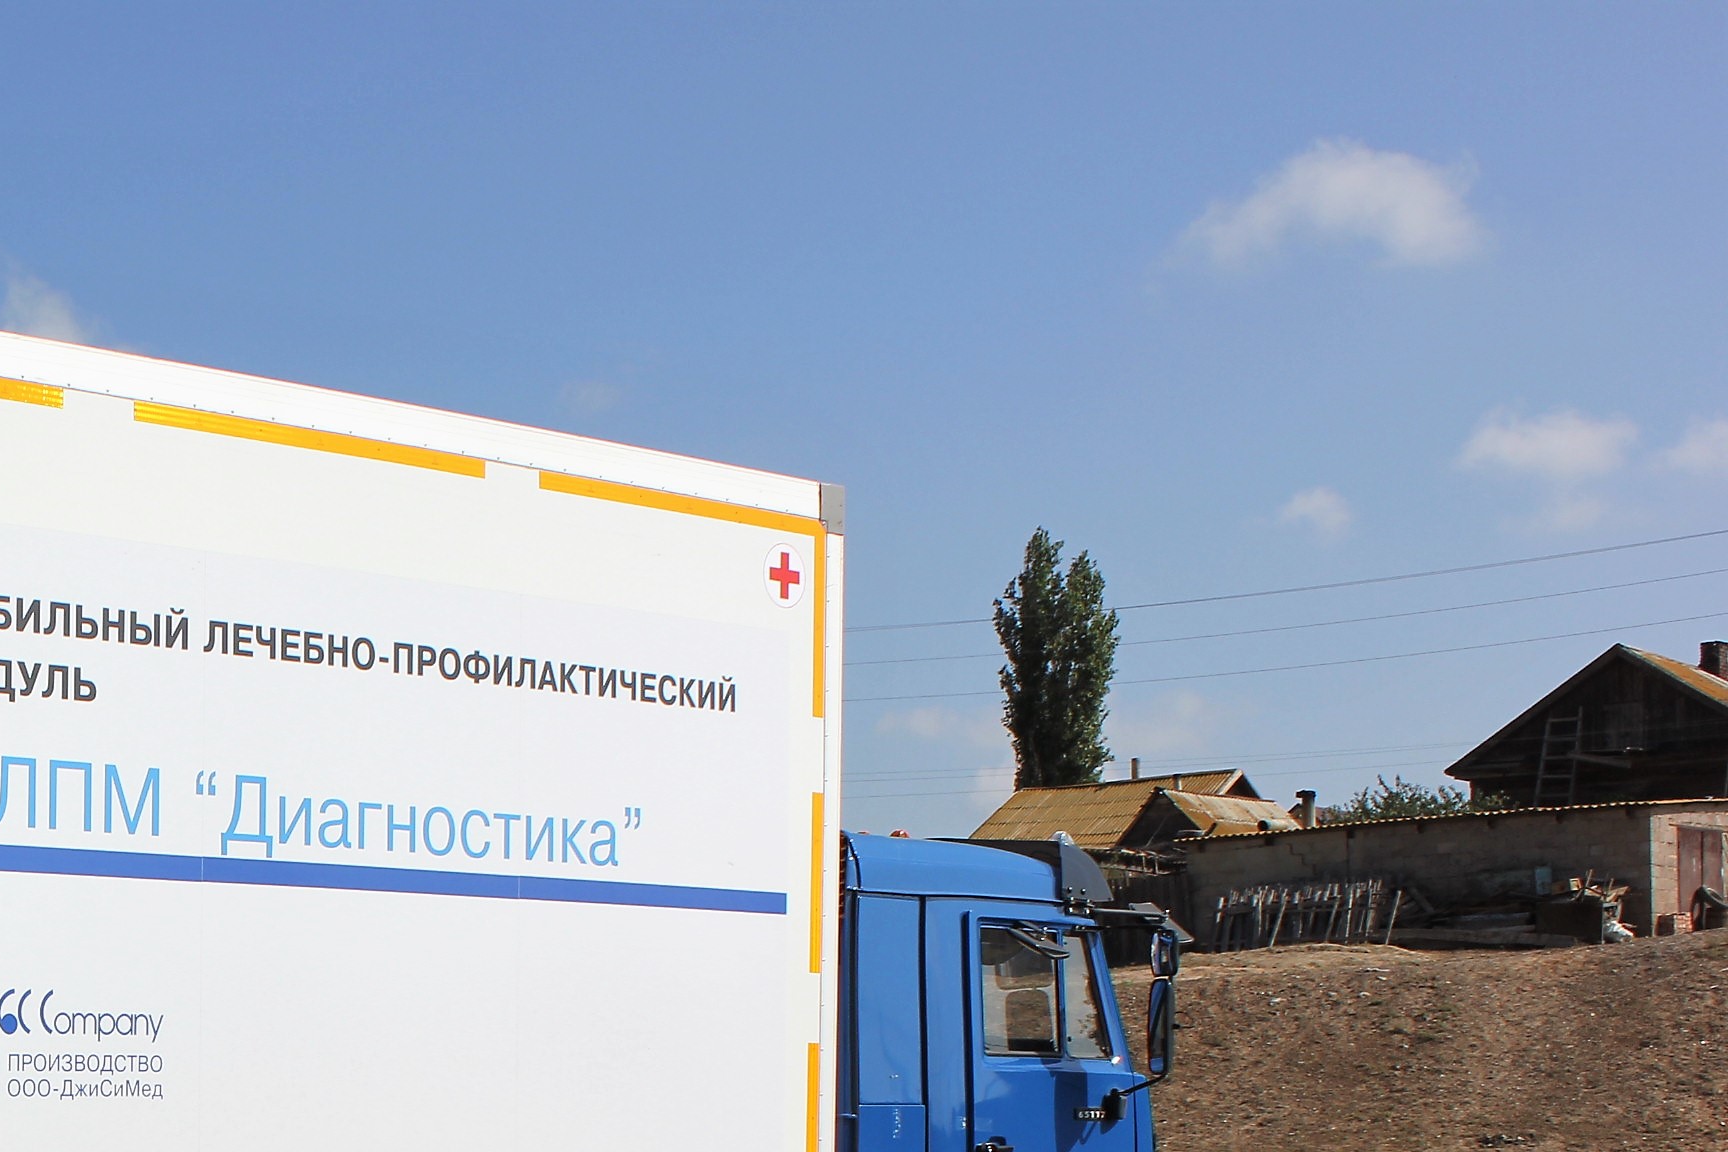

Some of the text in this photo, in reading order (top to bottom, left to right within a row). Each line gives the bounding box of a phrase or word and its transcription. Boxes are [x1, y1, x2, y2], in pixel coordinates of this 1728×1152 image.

[203, 620, 737, 712] ЛЕЧЕБНО-ПРОФИЛАКТИЧЕСКИЙ
[195, 770, 642, 867] “Диагностика”
[7, 1079, 164, 1100] ООО-ДжиСиМед
[8, 1053, 163, 1075] ПРОИЗВОДСТВО
